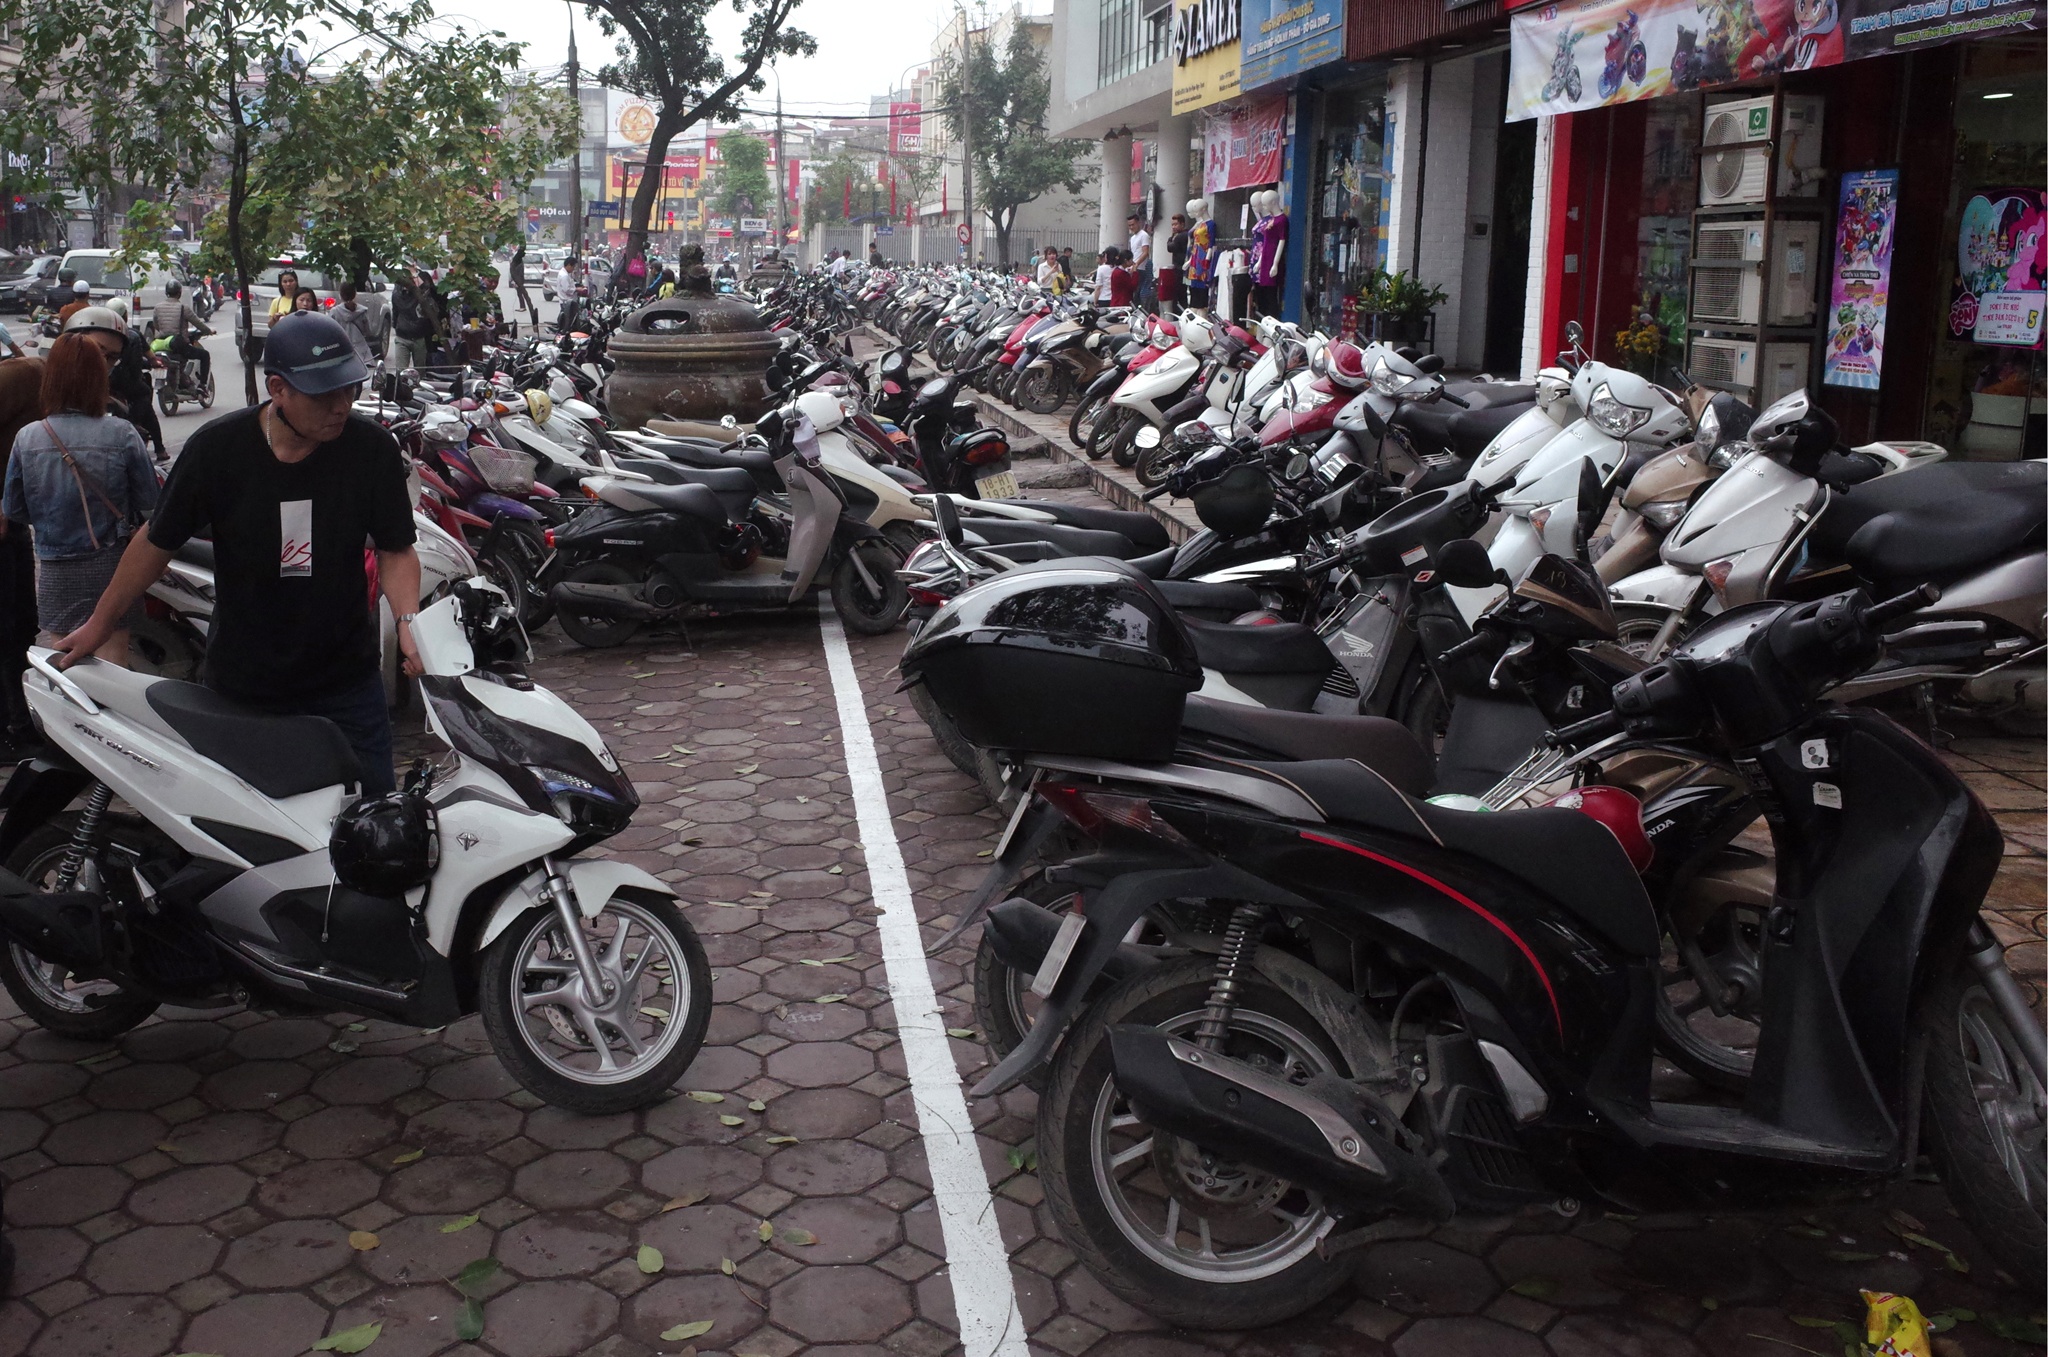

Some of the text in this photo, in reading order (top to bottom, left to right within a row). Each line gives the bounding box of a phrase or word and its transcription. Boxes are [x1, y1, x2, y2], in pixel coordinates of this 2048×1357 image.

[2027, 309, 2039, 329] 5
[986, 485, 1015, 499] 1933
[423, 565, 447, 578] HONDA
[1646, 818, 1676, 838] NDA
